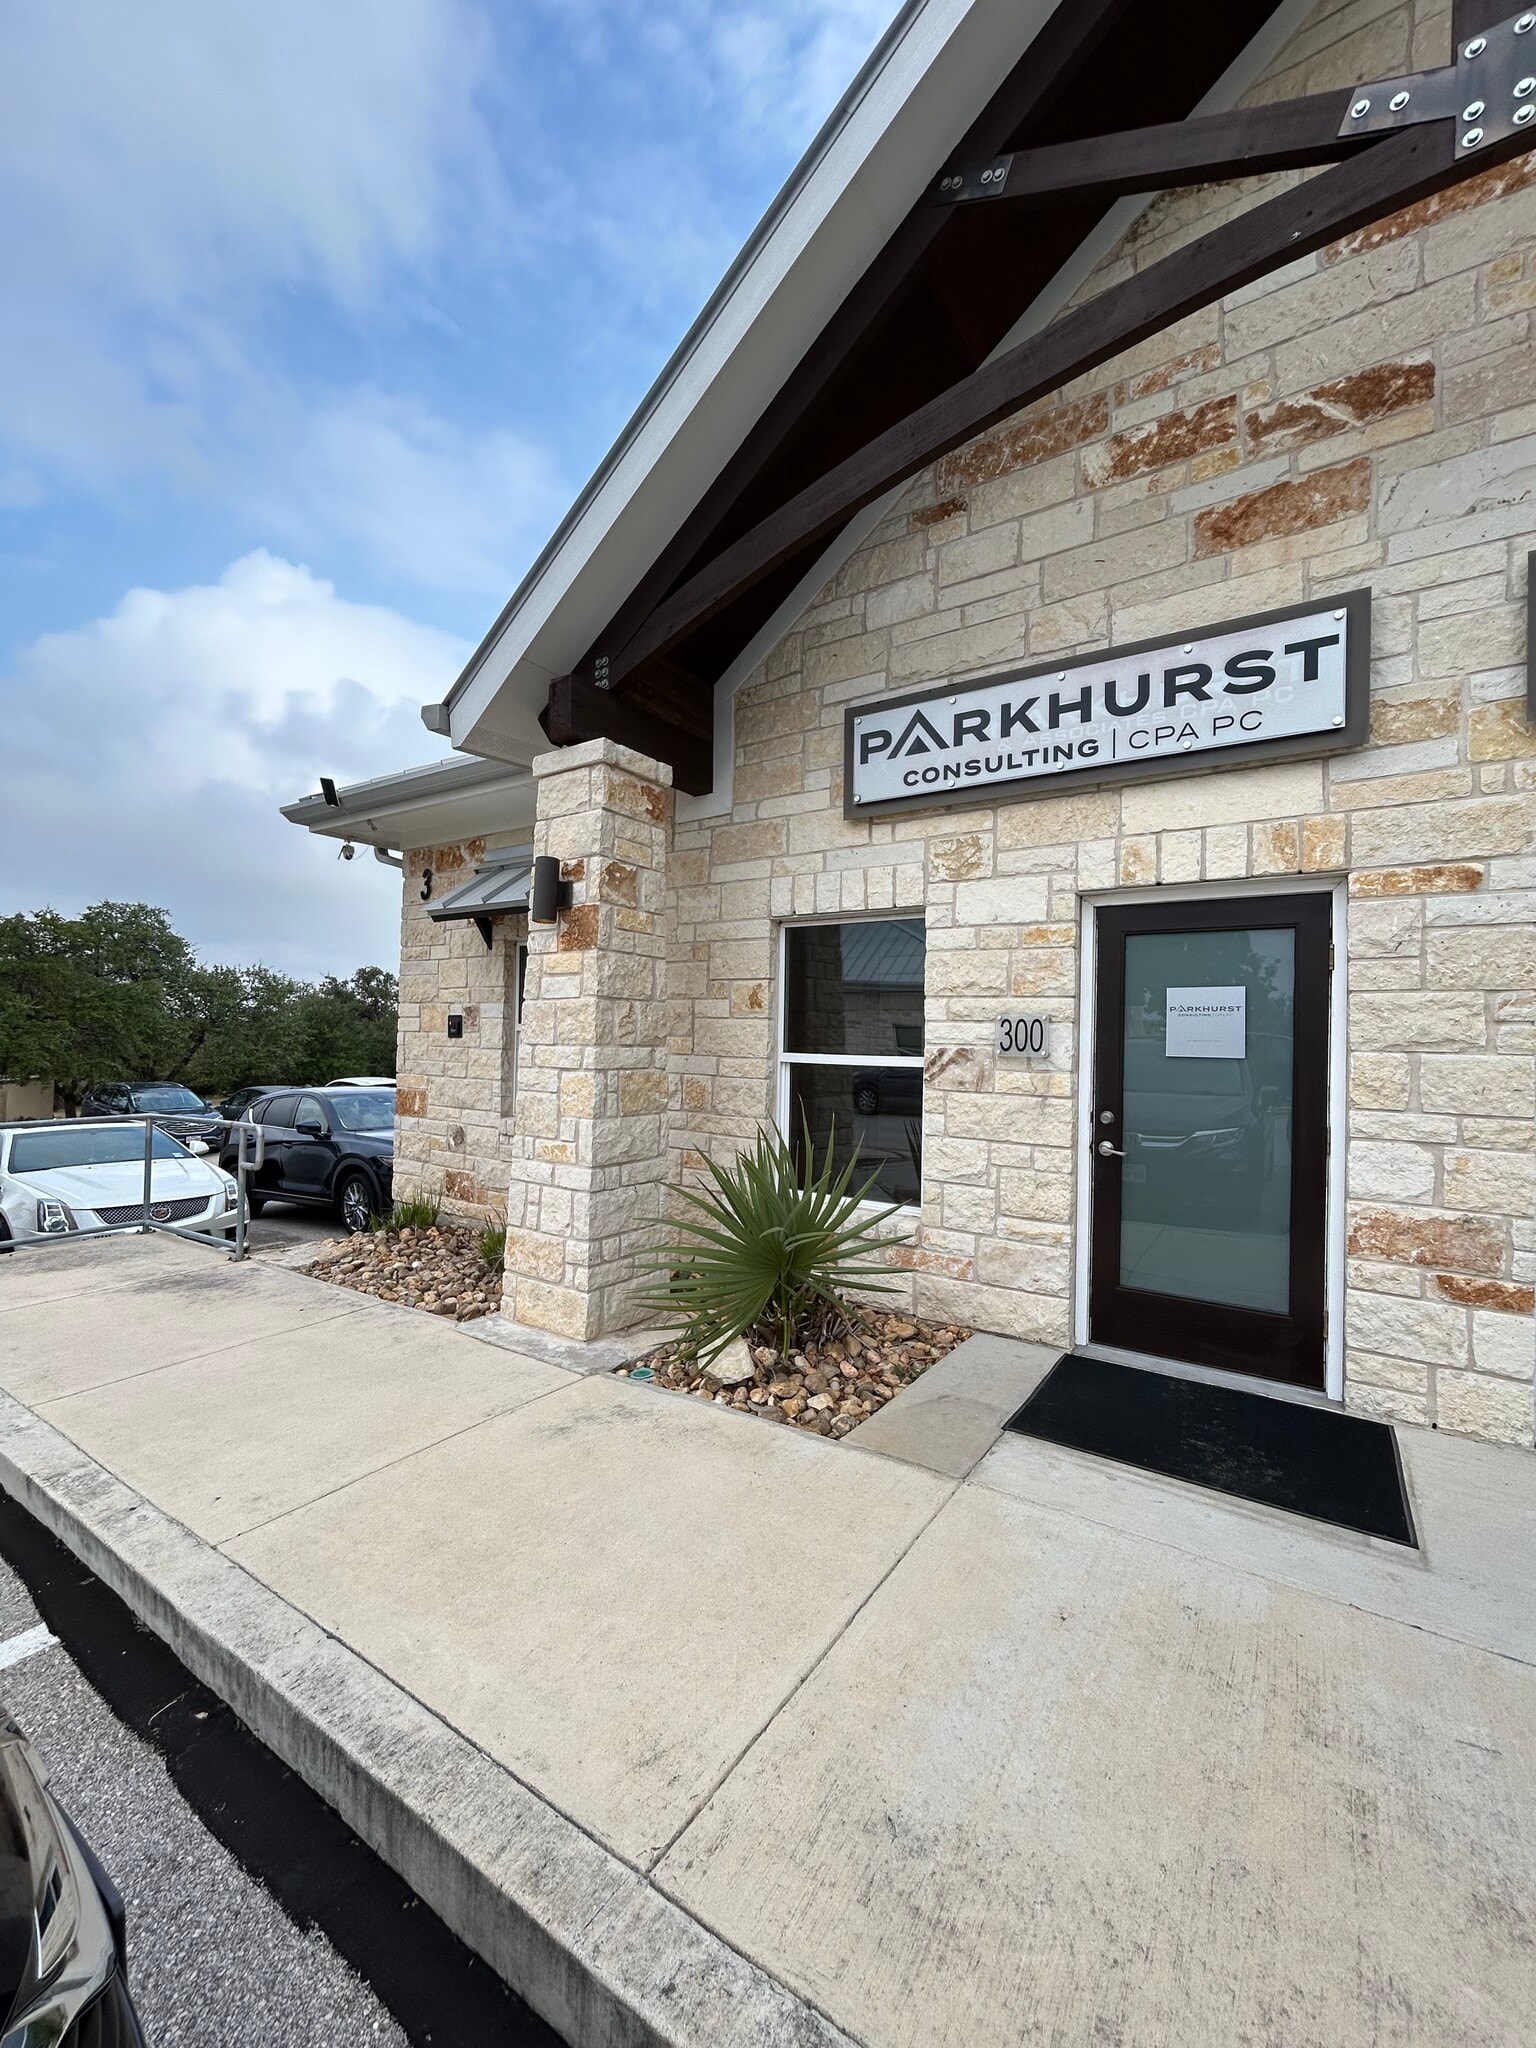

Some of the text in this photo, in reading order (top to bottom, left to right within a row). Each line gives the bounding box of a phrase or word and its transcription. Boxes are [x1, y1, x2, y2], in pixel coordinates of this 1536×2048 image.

[860, 634, 1340, 765] PARKHURST
[1022, 711, 1166, 748] ASSOCIATES
[1179, 696, 1237, 721] CPA
[1251, 685, 1294, 707] PC
[903, 710, 1263, 787] CONSULTING CPA PC
[420, 868, 433, 900] 3
[1169, 1005, 1242, 1013] PARKHURST
[1000, 1018, 1043, 1053] 300
